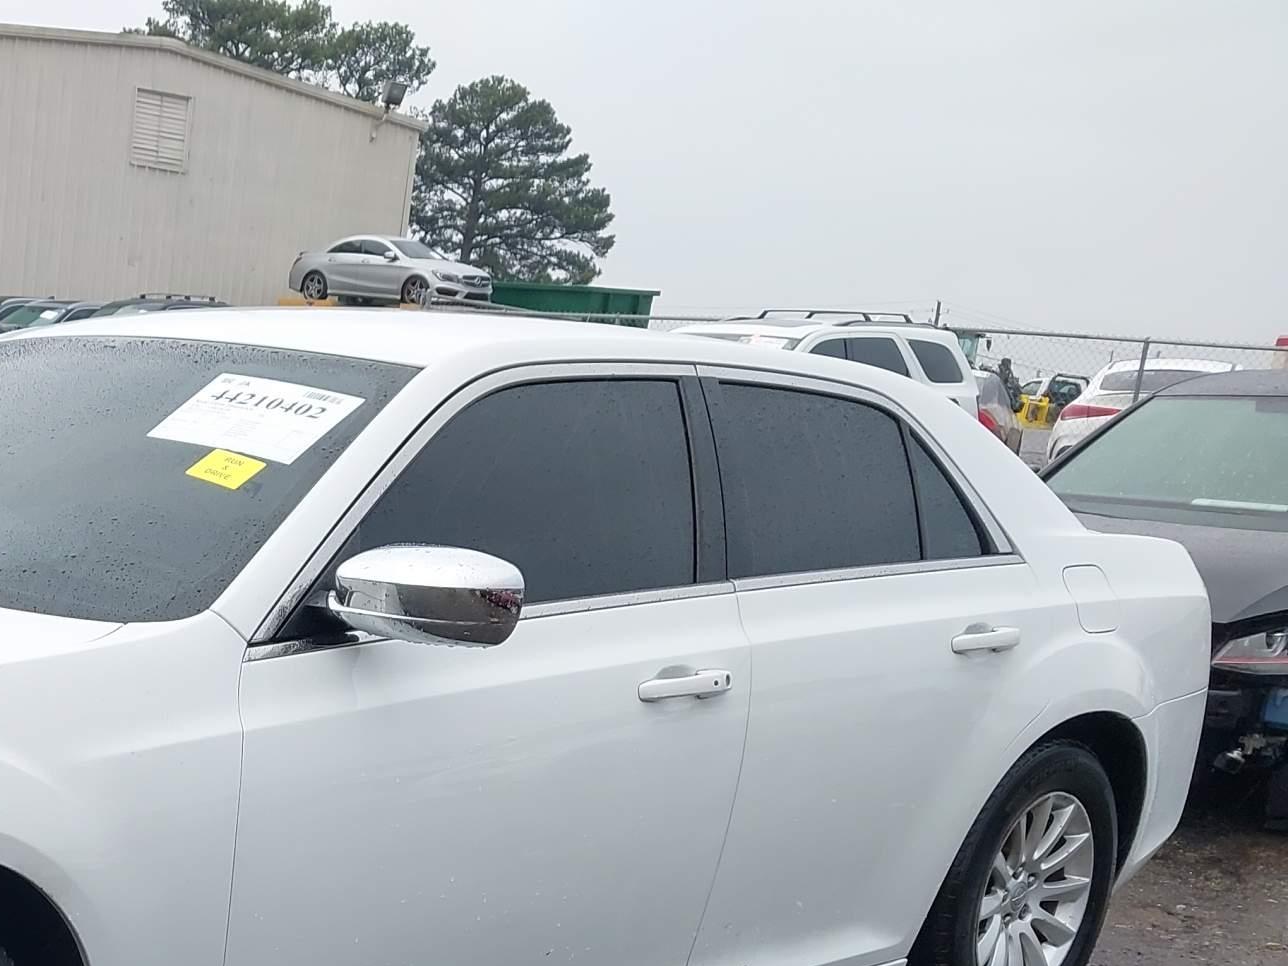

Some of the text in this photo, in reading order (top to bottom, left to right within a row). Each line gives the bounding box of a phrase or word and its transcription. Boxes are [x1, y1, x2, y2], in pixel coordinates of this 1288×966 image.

[210, 389, 328, 419] 44210402
[224, 457, 245, 467] RUN
[204, 468, 232, 481] DRIVE
